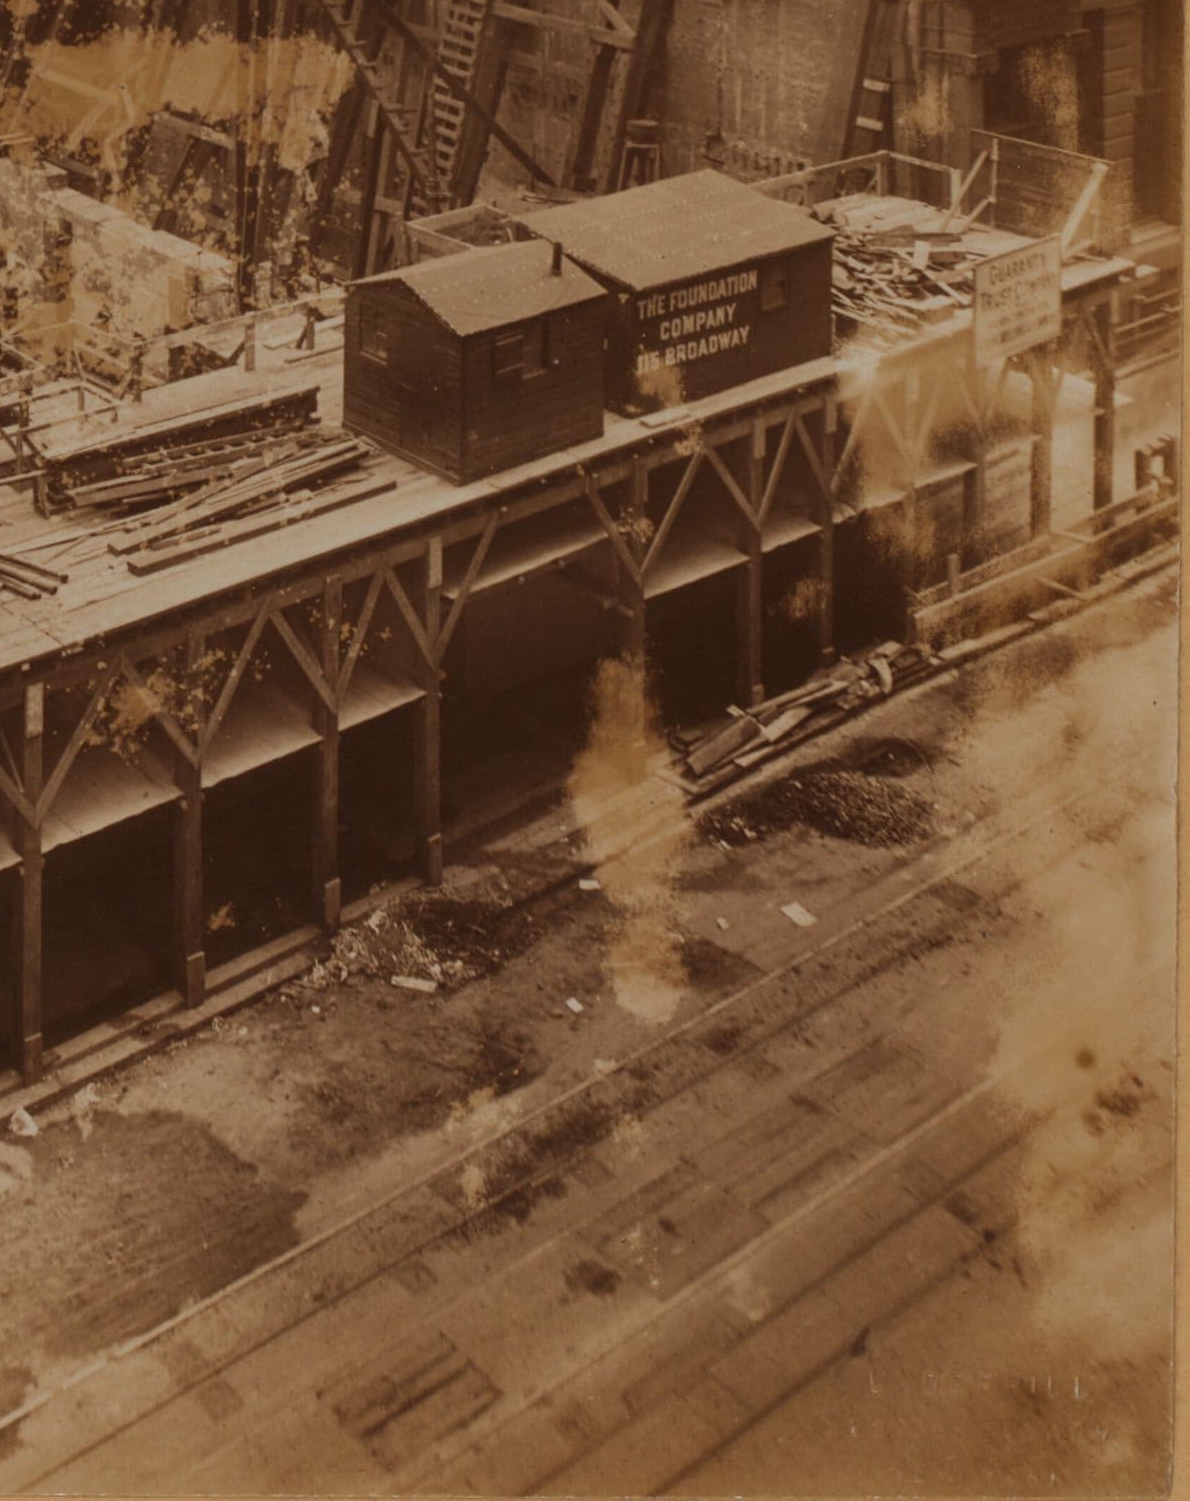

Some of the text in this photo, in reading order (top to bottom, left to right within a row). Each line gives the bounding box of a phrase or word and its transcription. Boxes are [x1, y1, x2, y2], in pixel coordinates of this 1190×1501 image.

[637, 269, 758, 321] THE FOUNDATION
[659, 302, 737, 341] COMPANY
[636, 324, 750, 377] 115 BROADWAY
